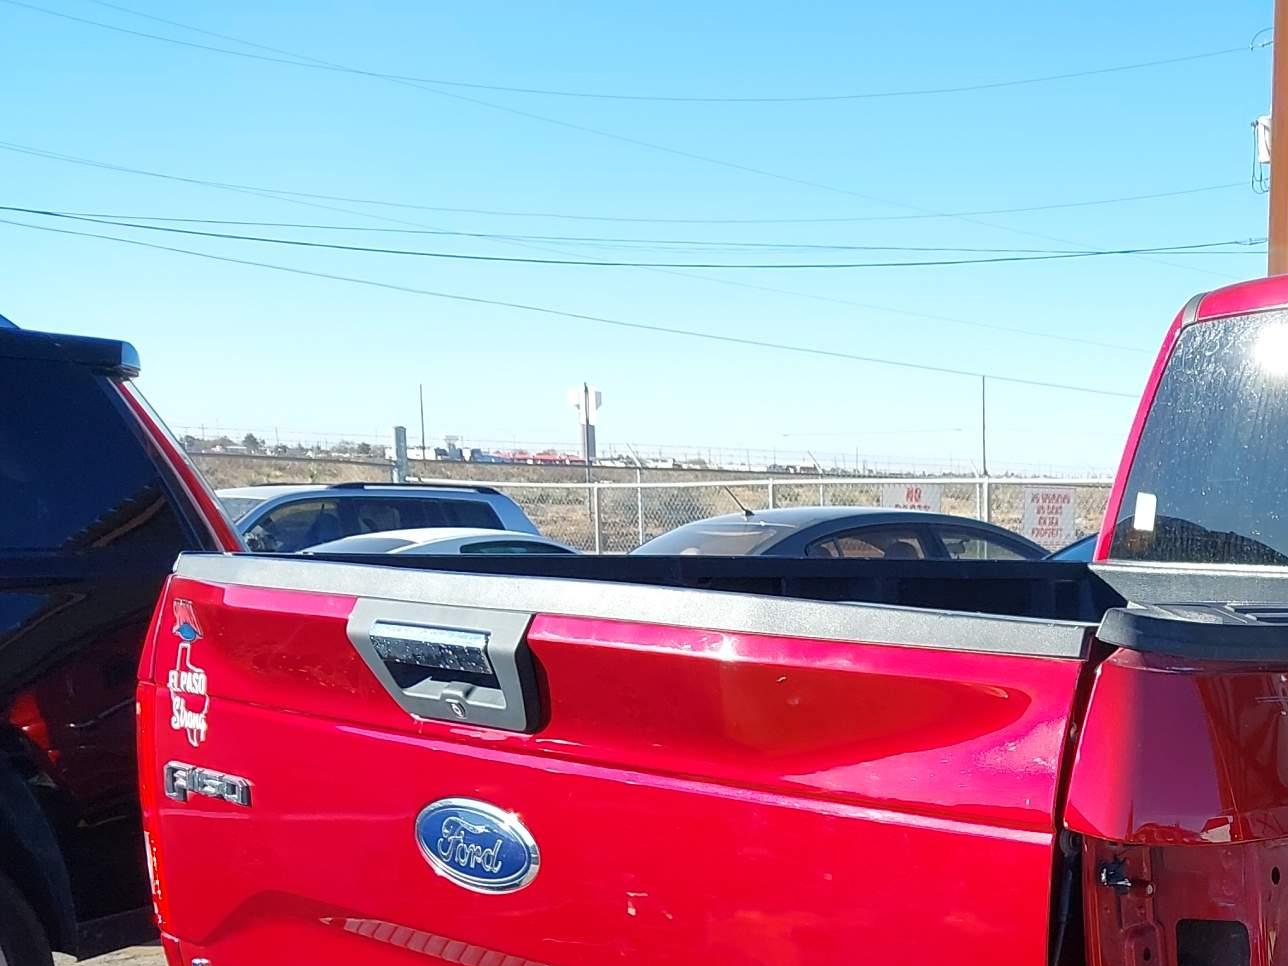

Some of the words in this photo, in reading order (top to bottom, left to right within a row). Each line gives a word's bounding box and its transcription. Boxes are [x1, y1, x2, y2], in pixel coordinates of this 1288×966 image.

[168, 670, 180, 692] EL
[180, 671, 207, 697] PASO
[171, 696, 207, 741] Strong
[437, 816, 503, 873] Ford
